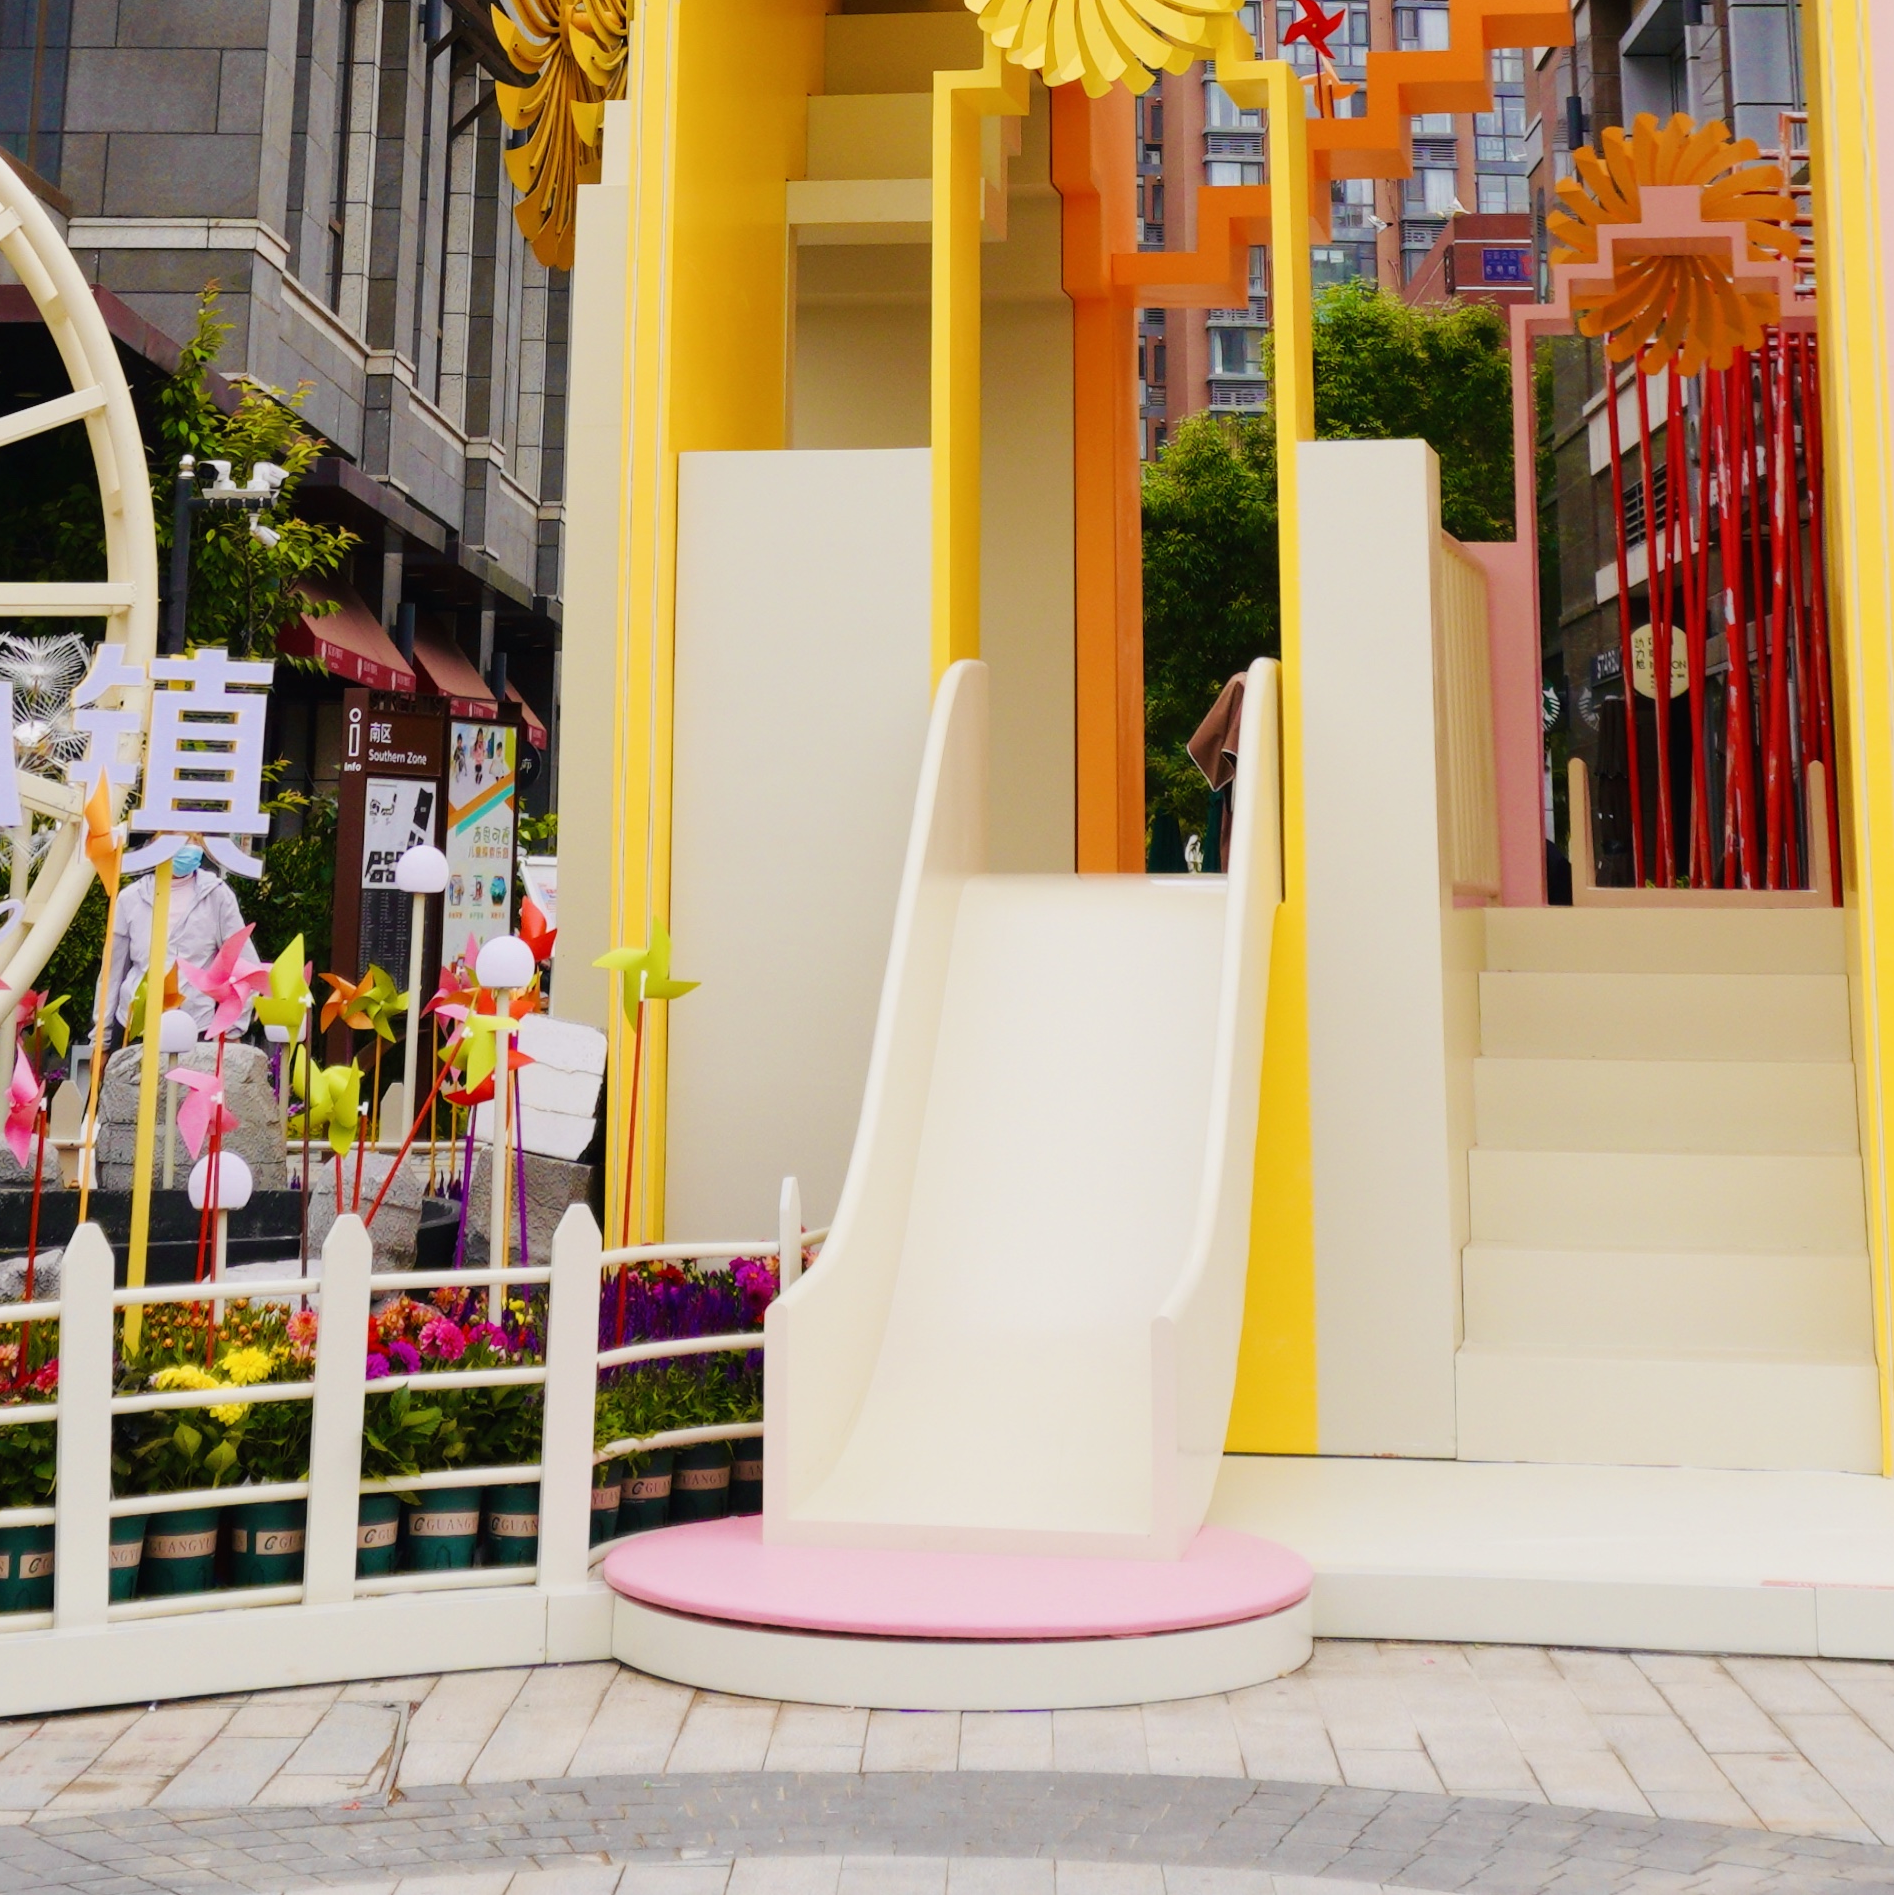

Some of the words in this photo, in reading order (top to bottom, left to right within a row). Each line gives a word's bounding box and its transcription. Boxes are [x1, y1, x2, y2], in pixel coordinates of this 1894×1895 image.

[369, 722, 392, 743] 南区
[368, 749, 406, 763] Southern
[406, 752, 427, 765] Zone
[344, 761, 362, 771] Info
